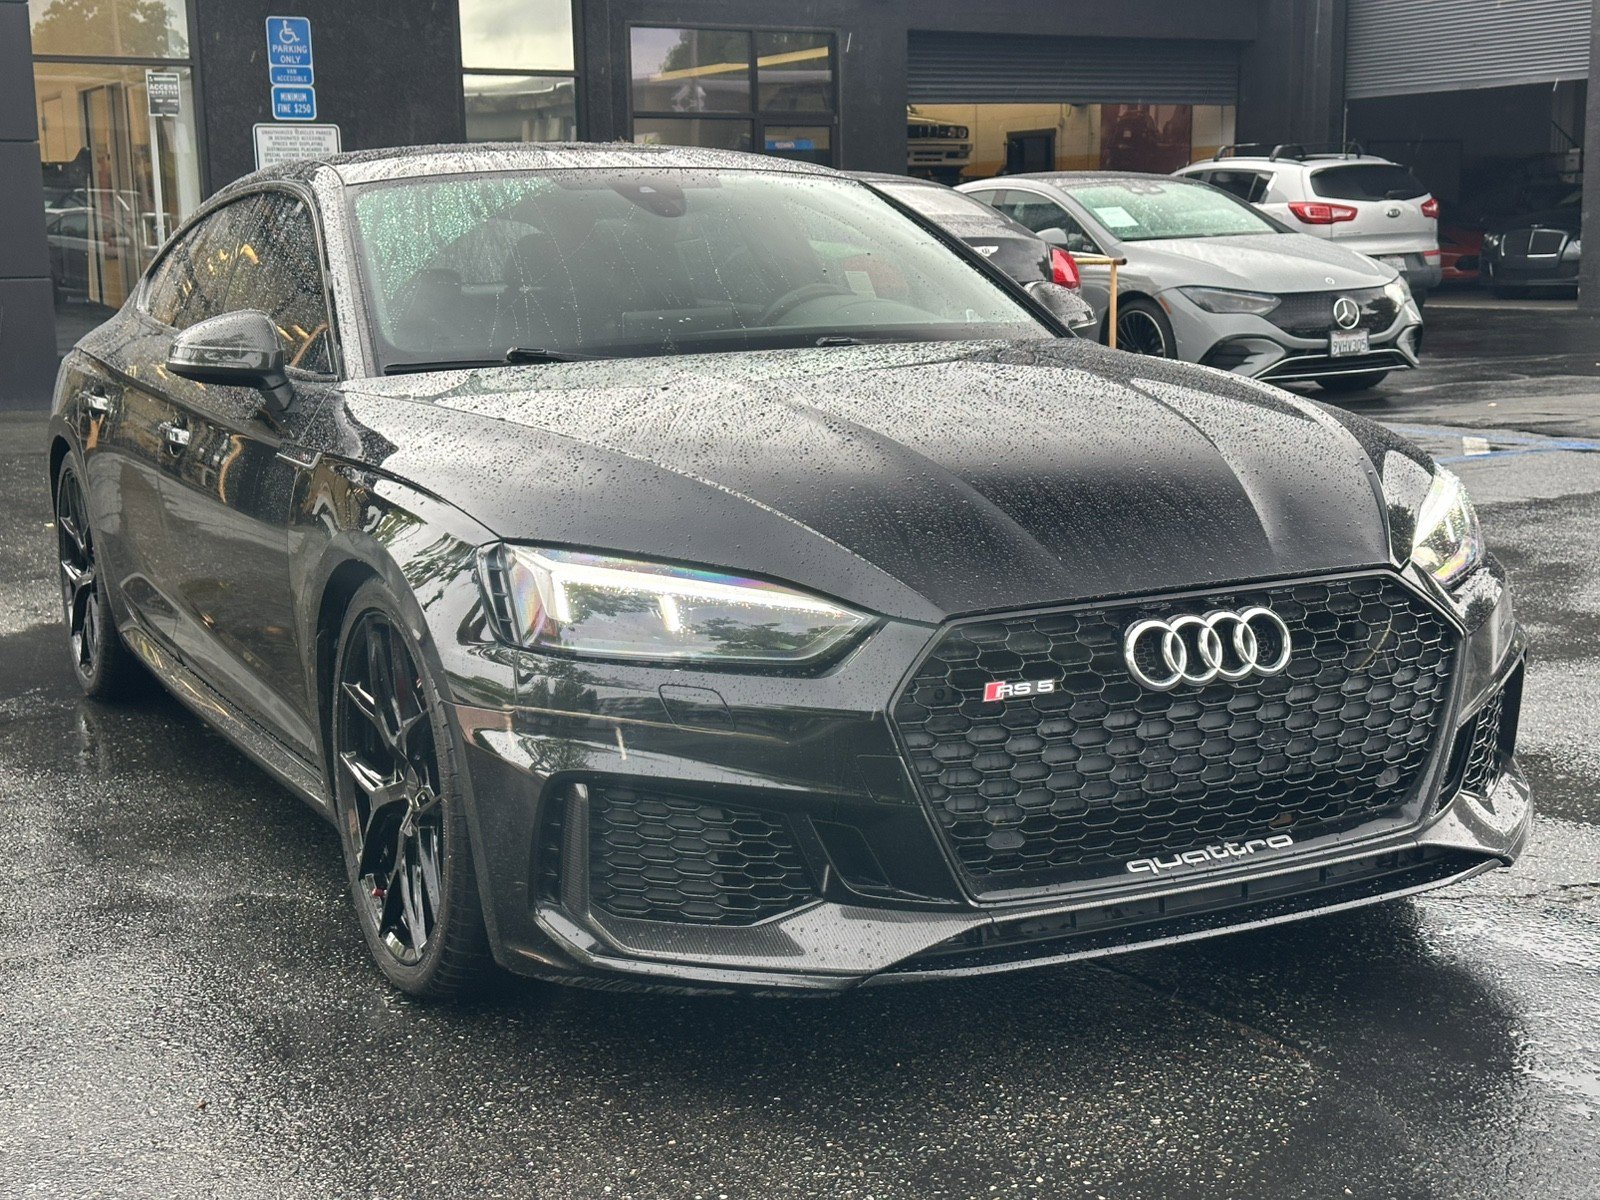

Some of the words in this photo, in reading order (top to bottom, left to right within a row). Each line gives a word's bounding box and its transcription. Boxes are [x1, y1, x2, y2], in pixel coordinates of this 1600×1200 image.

[272, 44, 308, 54] PARKING
[280, 55, 301, 64] ONLY
[280, 92, 307, 102] MINIMUM
[277, 103, 291, 114] FINE
[294, 103, 312, 114] $250
[994, 682, 1032, 699] RS
[1036, 680, 1054, 693] 5
[1125, 834, 1294, 876] quattro
